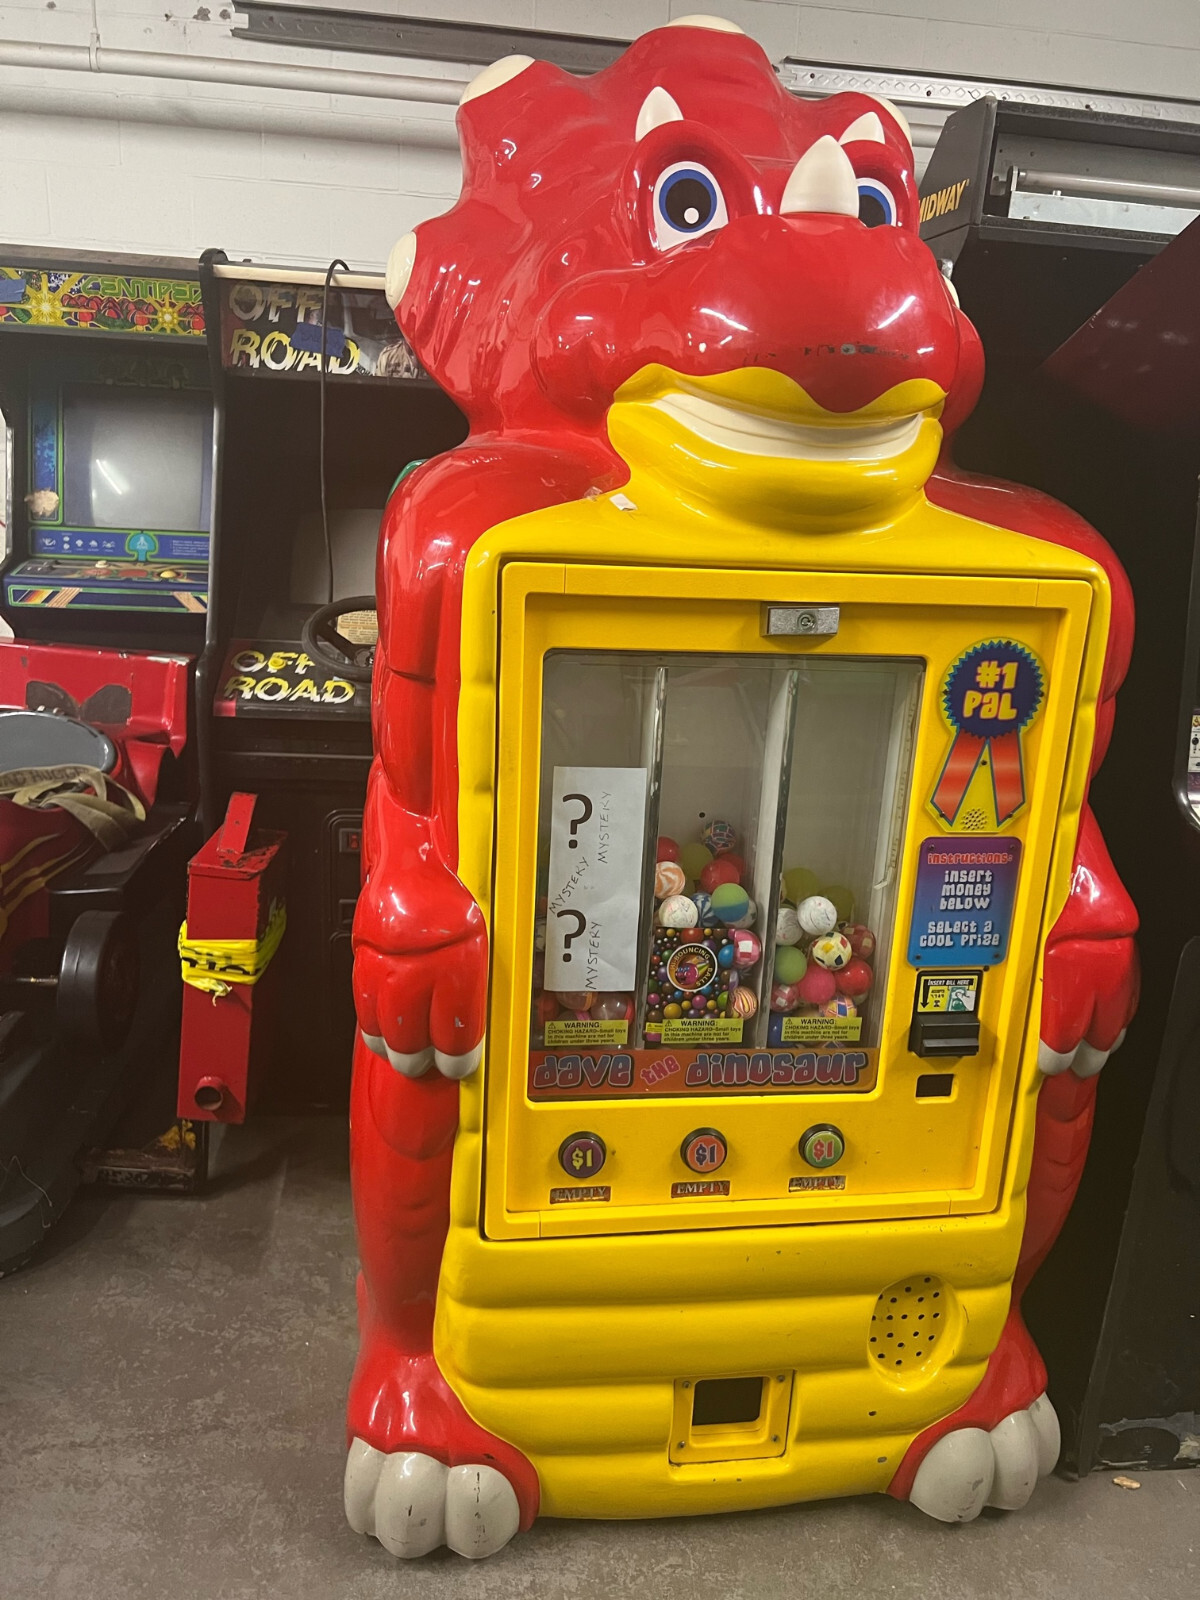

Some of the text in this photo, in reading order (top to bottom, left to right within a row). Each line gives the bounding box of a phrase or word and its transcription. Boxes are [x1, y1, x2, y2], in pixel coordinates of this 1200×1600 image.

[230, 281, 324, 323] OFF
[976, 661, 1018, 689] #1
[224, 675, 356, 704] ROAD
[597, 791, 612, 864] MYSTERY
[549, 856, 590, 914] MYSTERY
[585, 921, 602, 990] MYSTERY
[572, 1147, 593, 1170] $1
[694, 1141, 718, 1166] $1
[812, 1139, 835, 1163] $1
[677, 1182, 729, 1194] EMPTY
